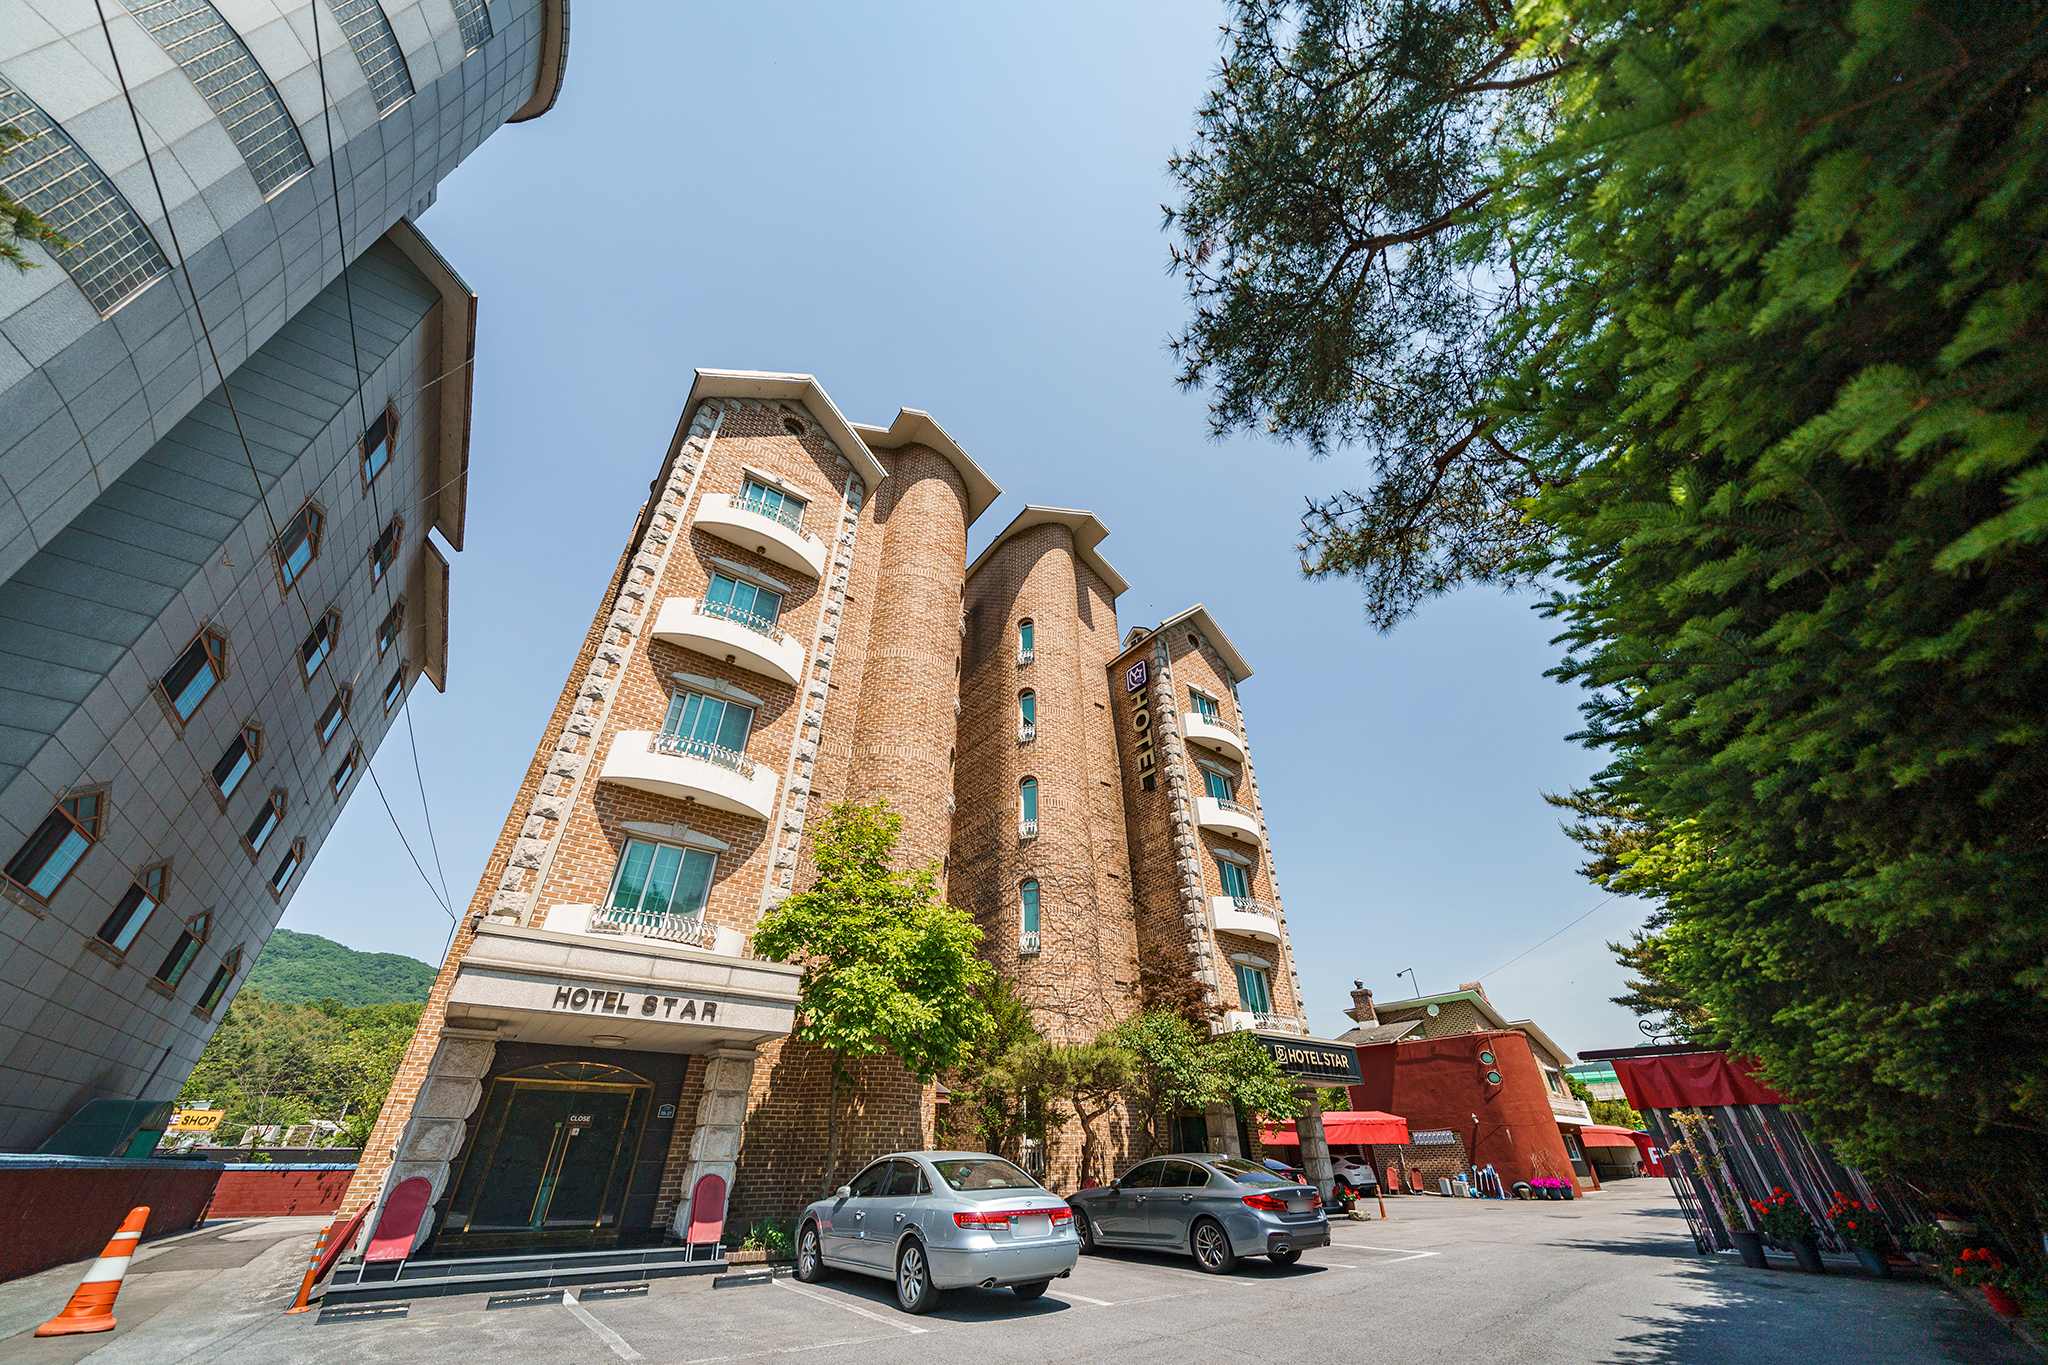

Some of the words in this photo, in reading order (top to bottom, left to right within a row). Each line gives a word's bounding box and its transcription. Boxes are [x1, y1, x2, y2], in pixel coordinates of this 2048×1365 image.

[1131, 687, 1157, 791] HOTEL
[552, 986, 629, 1015] HOTEL
[641, 995, 718, 1022] STAR
[1287, 1048, 1323, 1065] HOTEL
[1322, 1053, 1350, 1068] STAR
[181, 1115, 217, 1126] SHOP
